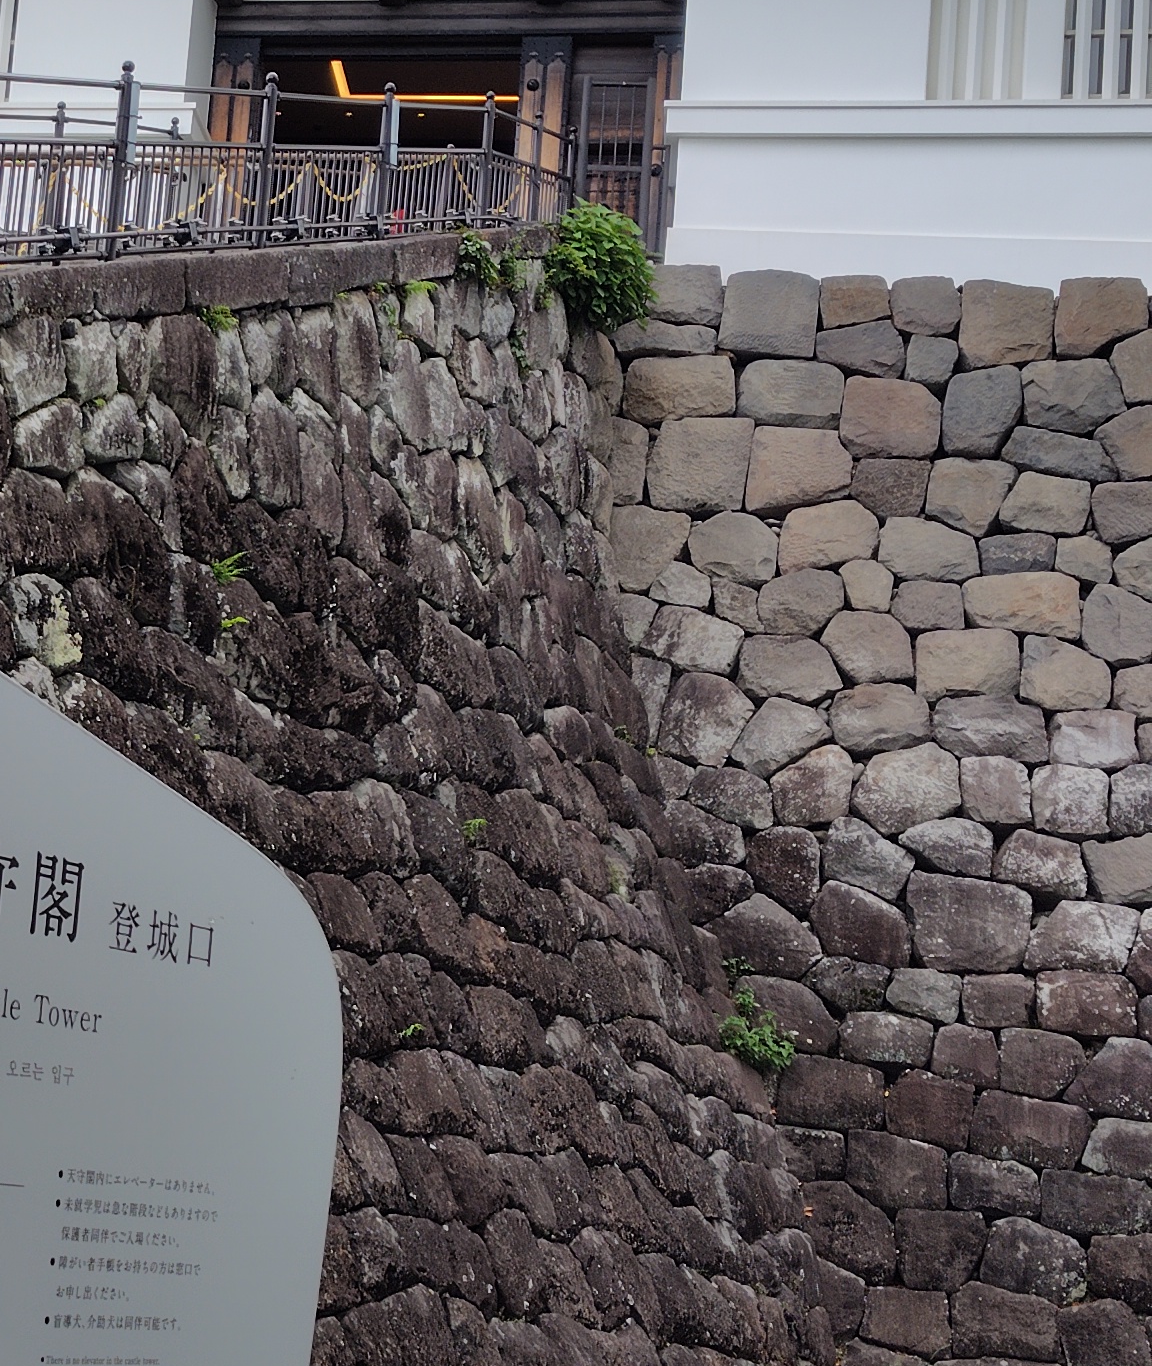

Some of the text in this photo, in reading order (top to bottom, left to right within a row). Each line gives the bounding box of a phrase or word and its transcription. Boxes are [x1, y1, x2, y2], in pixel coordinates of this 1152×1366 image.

[109, 902, 213, 967] 登城口
[34, 995, 102, 1032] Tower
[7, 1060, 44, 1081] 오르는
[52, 1065, 74, 1085] 입구
[46, 1356, 63, 1364] There
[66, 1357, 71, 1365] is
[81, 1356, 105, 1365] elevator
[106, 1357, 112, 1365] in
[114, 1356, 123, 1365] the
[125, 1357, 141, 1365] castle
